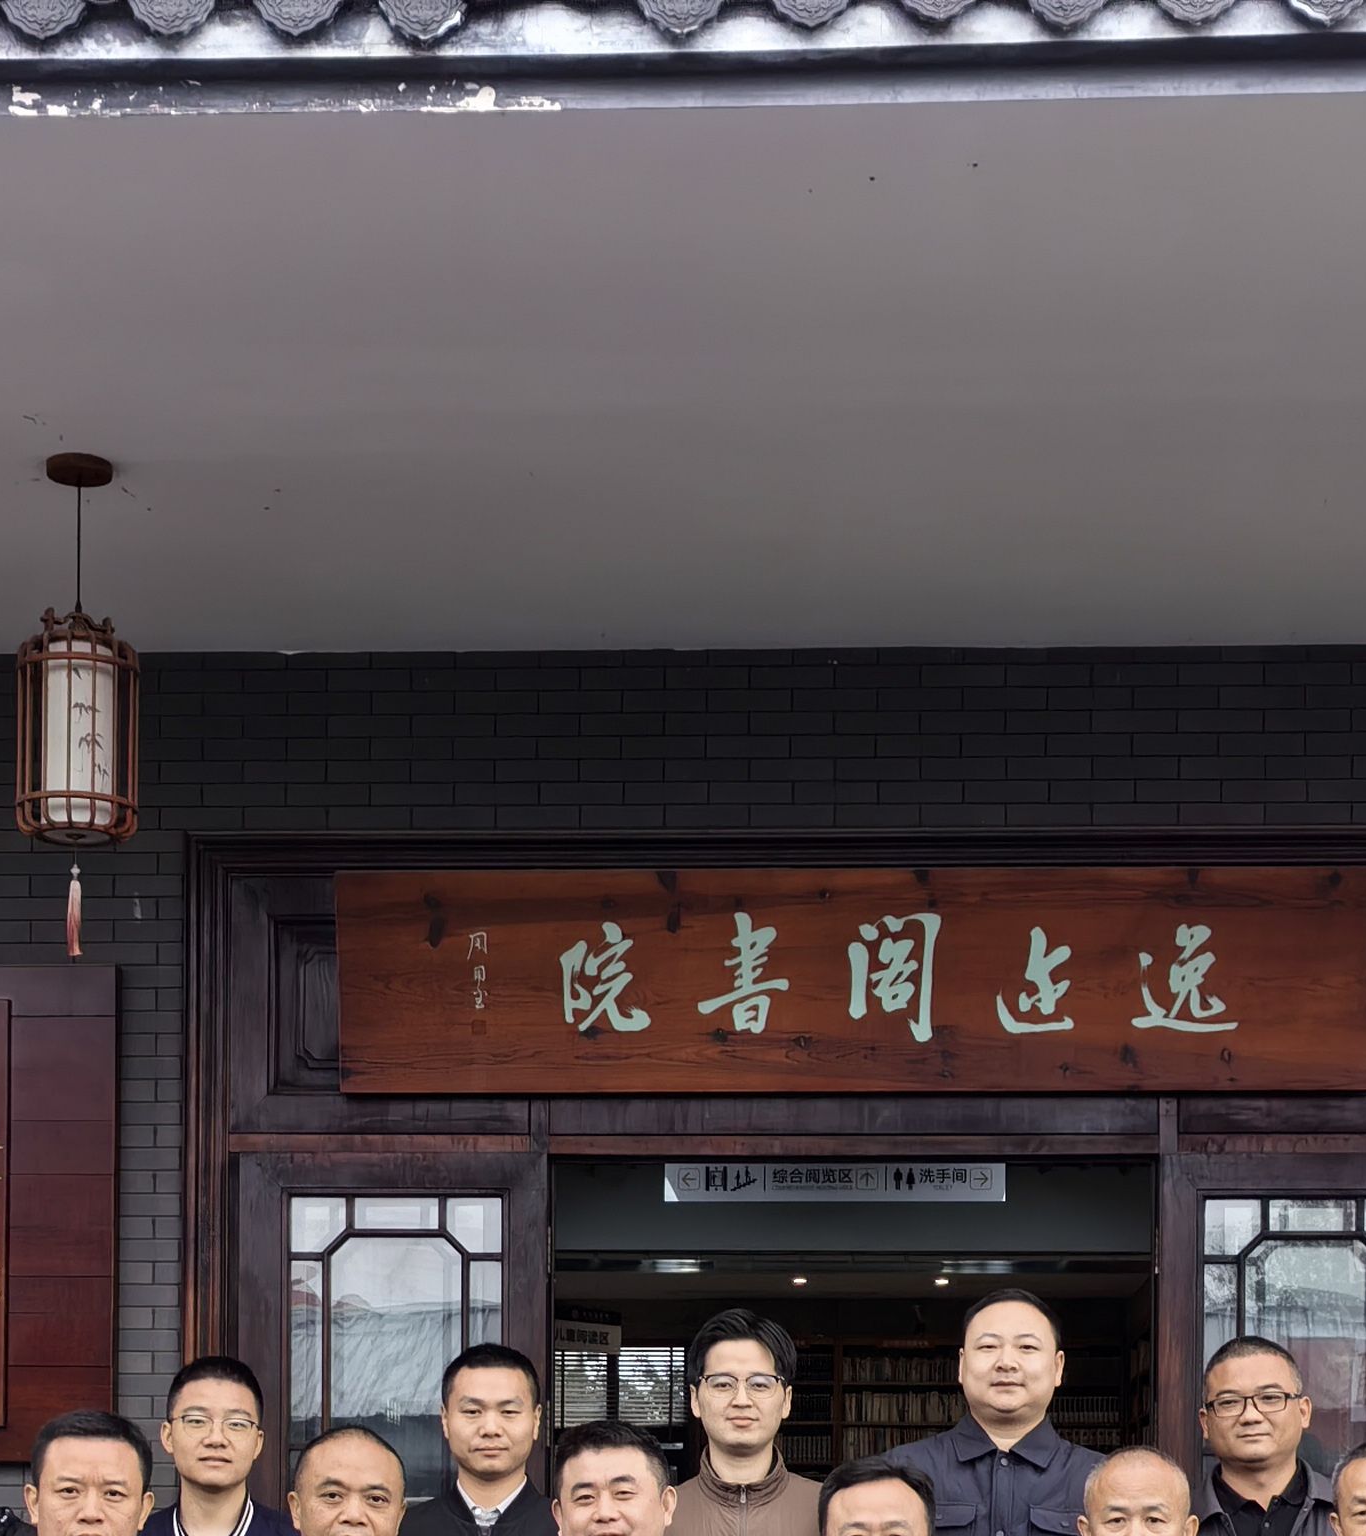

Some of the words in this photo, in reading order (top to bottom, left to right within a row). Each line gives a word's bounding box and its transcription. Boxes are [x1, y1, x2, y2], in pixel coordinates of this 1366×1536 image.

[771, 1168, 854, 1185] 综合阅览区
[919, 1168, 968, 1184] 洗手间
